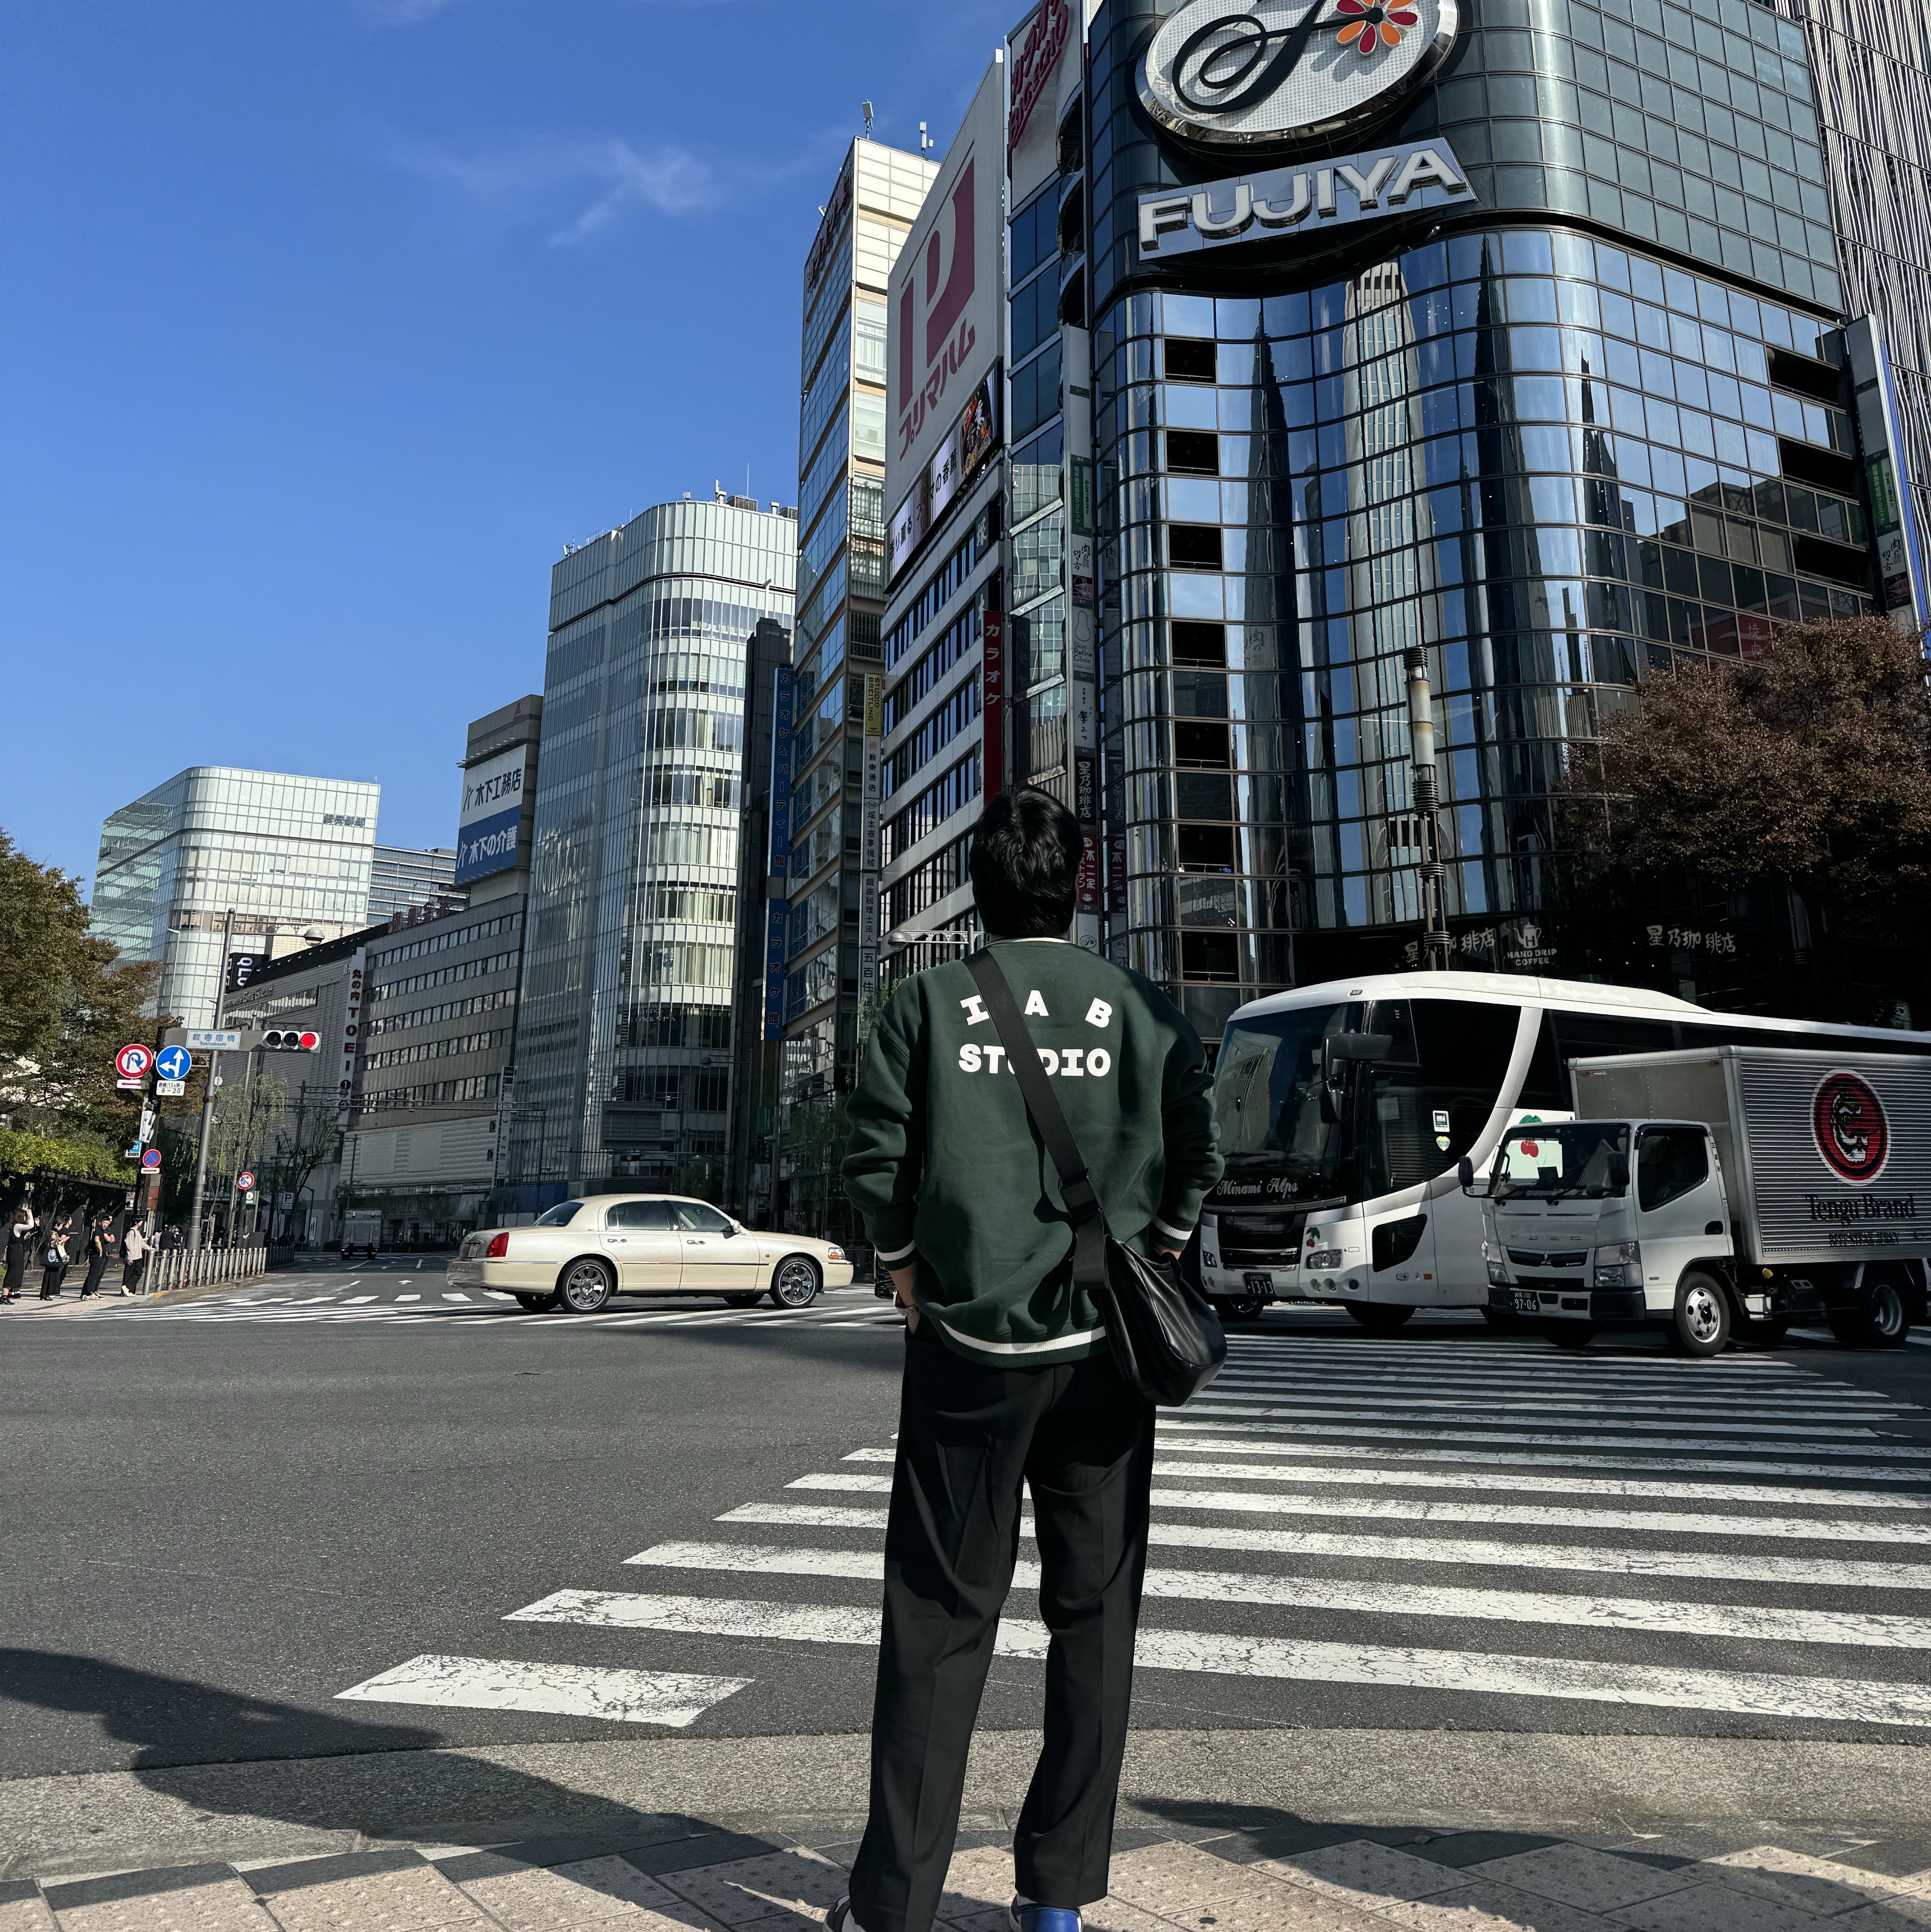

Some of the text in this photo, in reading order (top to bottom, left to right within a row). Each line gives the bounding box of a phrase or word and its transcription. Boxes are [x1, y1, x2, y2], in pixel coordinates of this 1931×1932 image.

[1140, 148, 1468, 251] FUJIYA
[899, 318, 975, 461] プリマハム
[986, 624, 1000, 705] カラオケ
[1074, 648, 1092, 657] Refine
[1074, 655, 1091, 664] Clinic
[474, 768, 522, 807] 木下工務店
[1078, 761, 1092, 819] 星乃珈琲店
[468, 825, 518, 865] 木下の介護
[867, 811, 876, 867] 塚本商事機械
[1086, 850, 1096, 890] 不二家
[865, 877, 874, 942] 銀座税理士法人
[1507, 948, 1557, 959] HAND DRIP
[1647, 924, 1736, 955] 星乃珈琲店
[768, 912, 783, 1025] カラオケ館
[1515, 957, 1550, 966] COFFEE
[192, 1033, 235, 1042] 数寄屋橋
[1217, 1177, 1299, 1199] Minami Alps
[1805, 1193, 1915, 1226] Tengu Brand
[1514, 1299, 1537, 1310] 97-06
